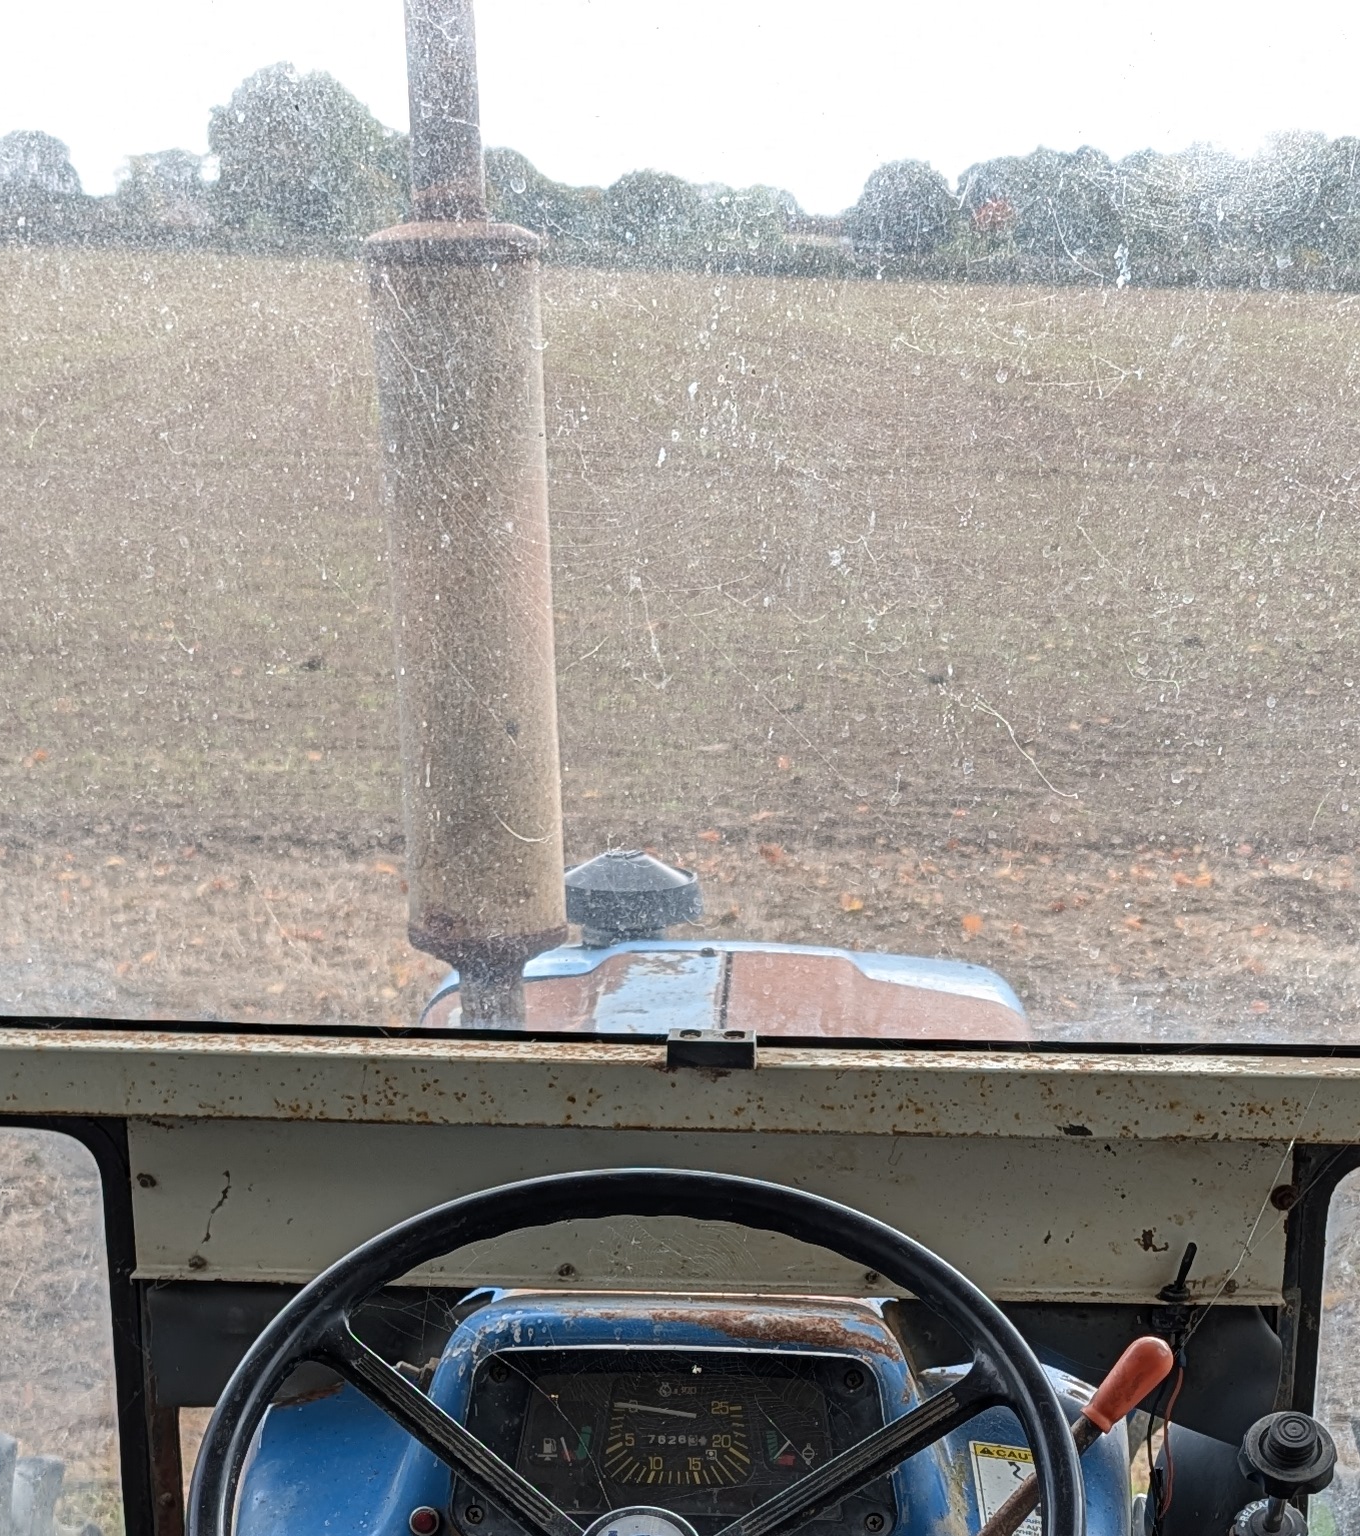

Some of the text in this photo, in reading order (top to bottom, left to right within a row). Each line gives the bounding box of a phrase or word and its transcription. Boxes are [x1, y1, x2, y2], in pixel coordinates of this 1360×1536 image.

[711, 1401, 729, 1415] 25
[624, 1432, 635, 1447] 5
[712, 1434, 731, 1448] 20
[648, 1456, 663, 1470] 10
[687, 1457, 702, 1471] 15
